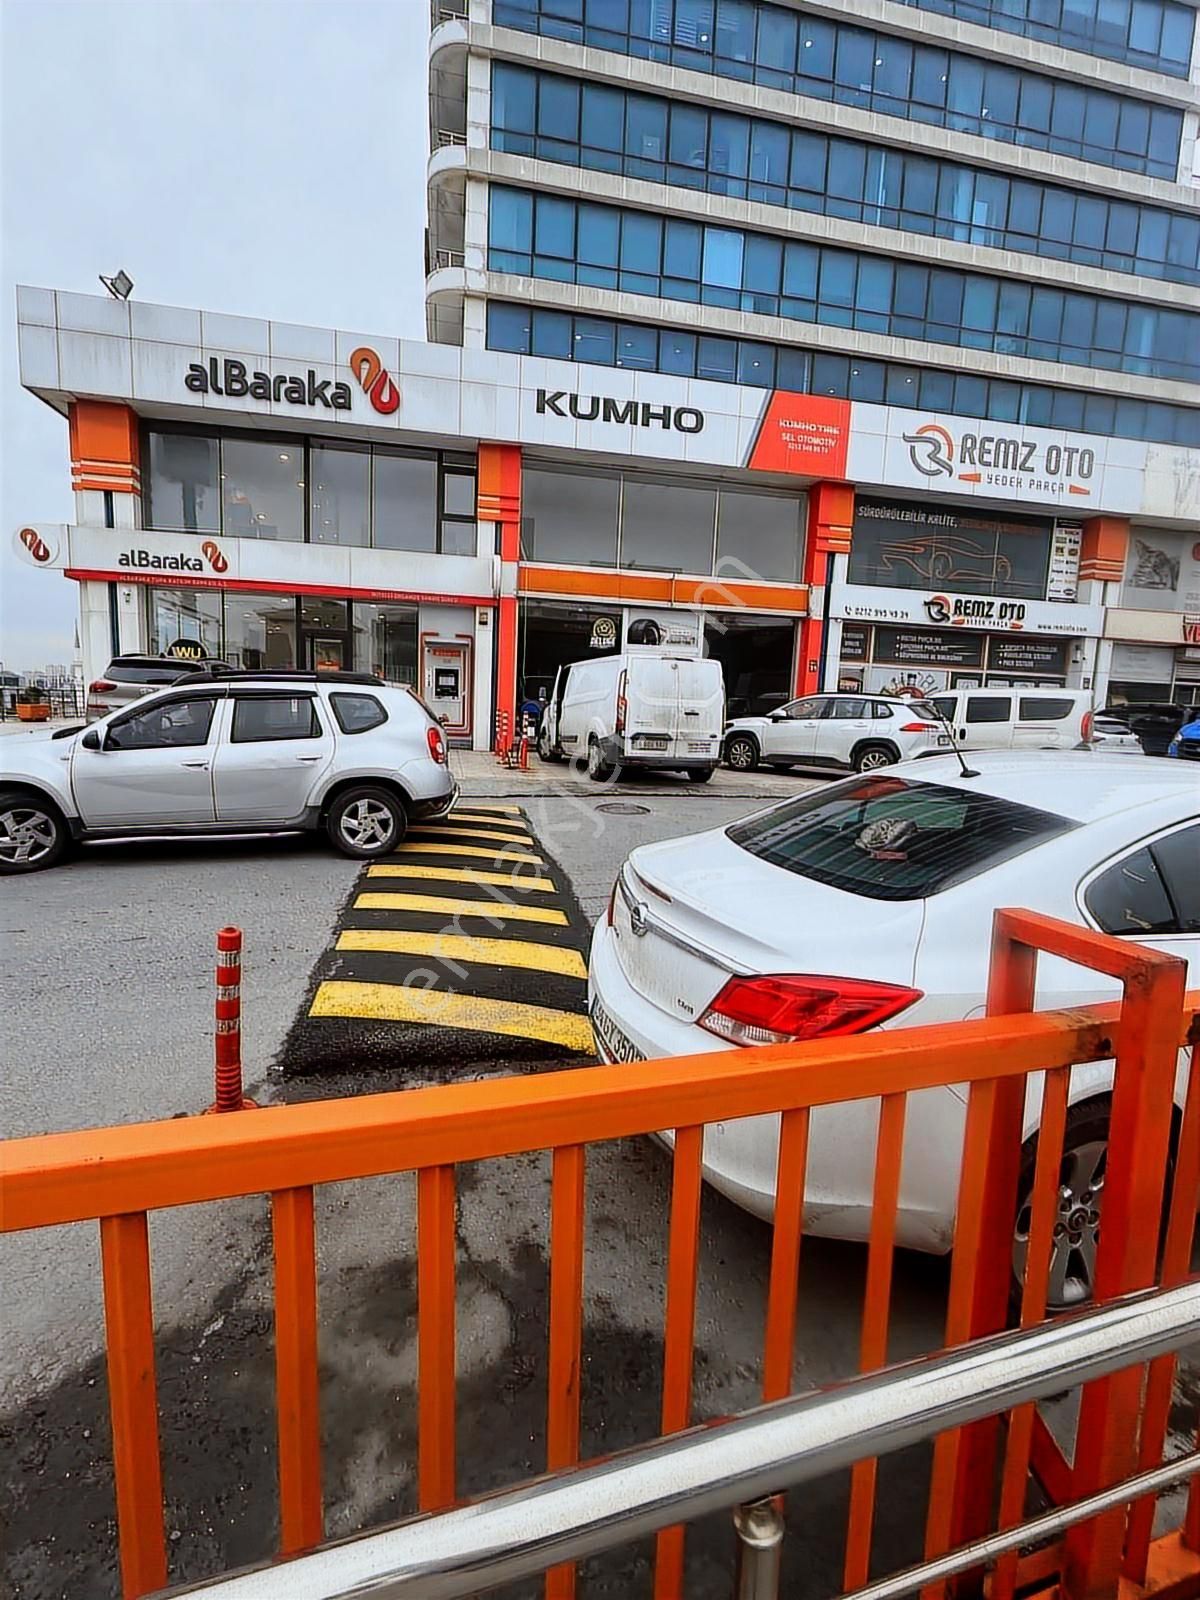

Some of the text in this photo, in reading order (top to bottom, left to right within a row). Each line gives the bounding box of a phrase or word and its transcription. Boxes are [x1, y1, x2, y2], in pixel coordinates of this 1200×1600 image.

[184, 357, 352, 410] alBaraka
[535, 388, 704, 434] KUMHO
[780, 418, 840, 435] KUMHO TIRE
[960, 433, 1095, 479] REMZ OTO
[986, 473, 1064, 494] YEDEK PARÇA
[118, 550, 204, 572] alBaraka
[953, 599, 1026, 620] REMZ OTO
